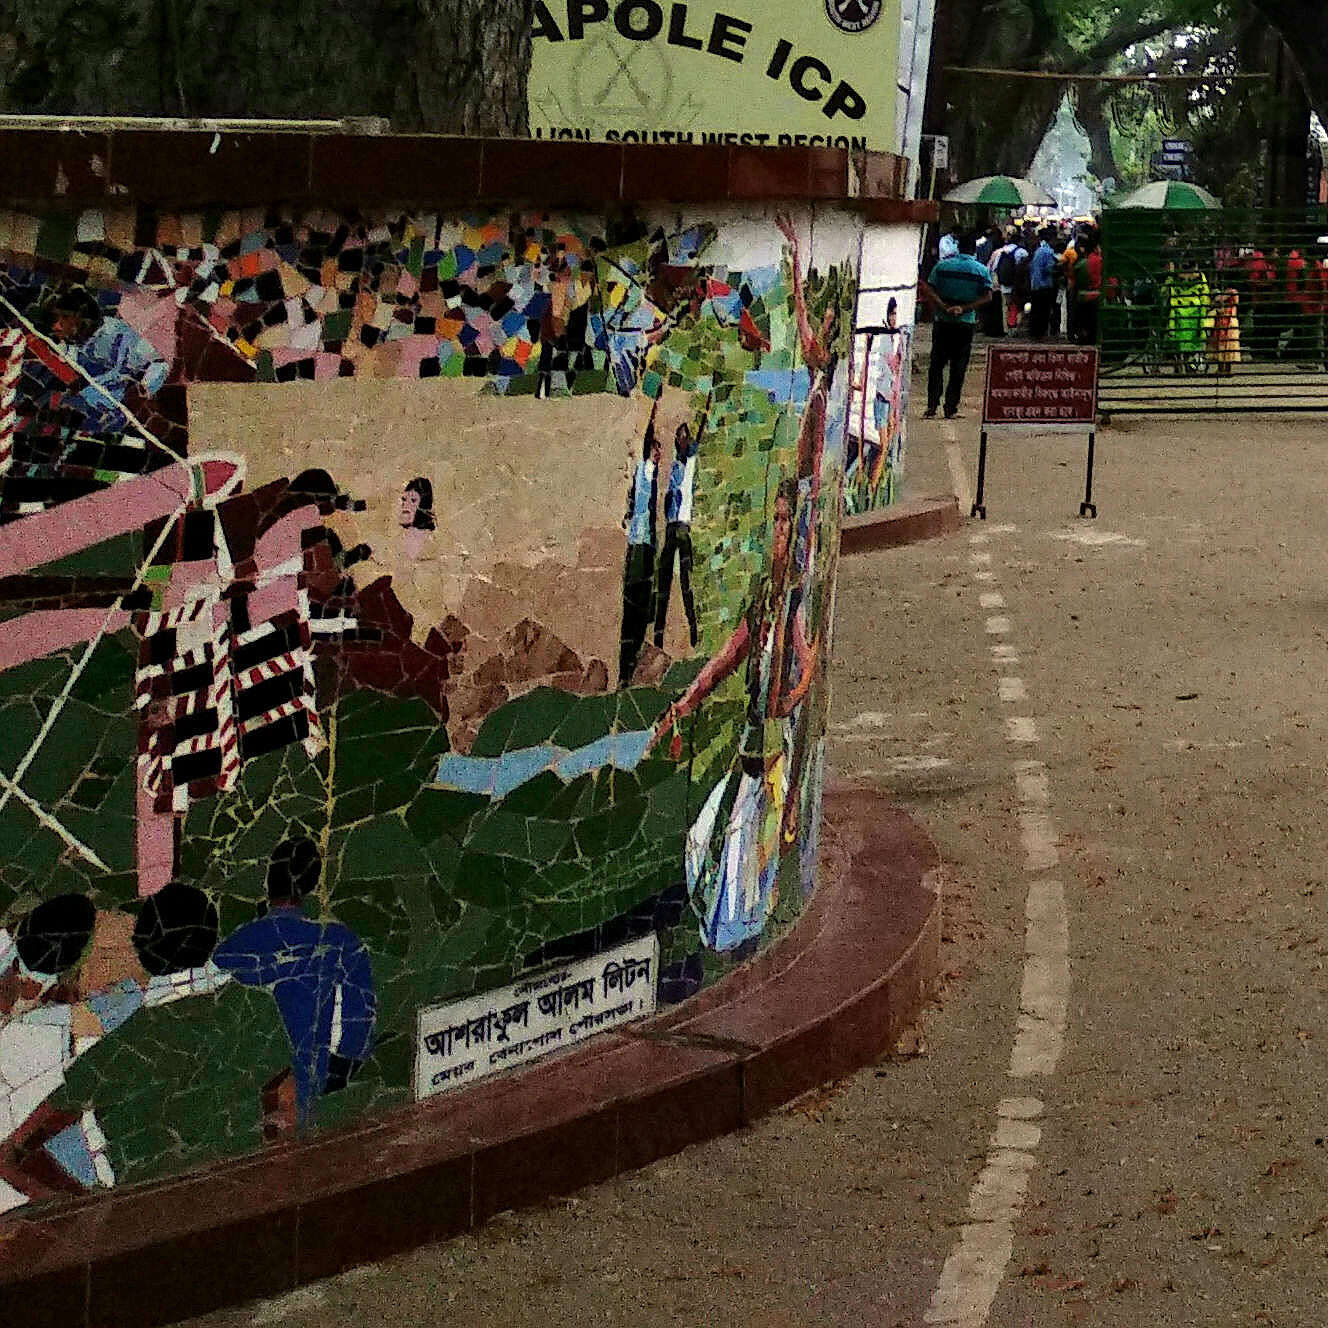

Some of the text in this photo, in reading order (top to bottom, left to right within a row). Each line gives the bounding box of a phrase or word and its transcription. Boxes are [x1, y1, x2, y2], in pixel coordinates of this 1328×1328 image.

[766, 38, 868, 121] ICP
[537, 977, 596, 1018] আলম
[602, 957, 652, 999] লিটন
